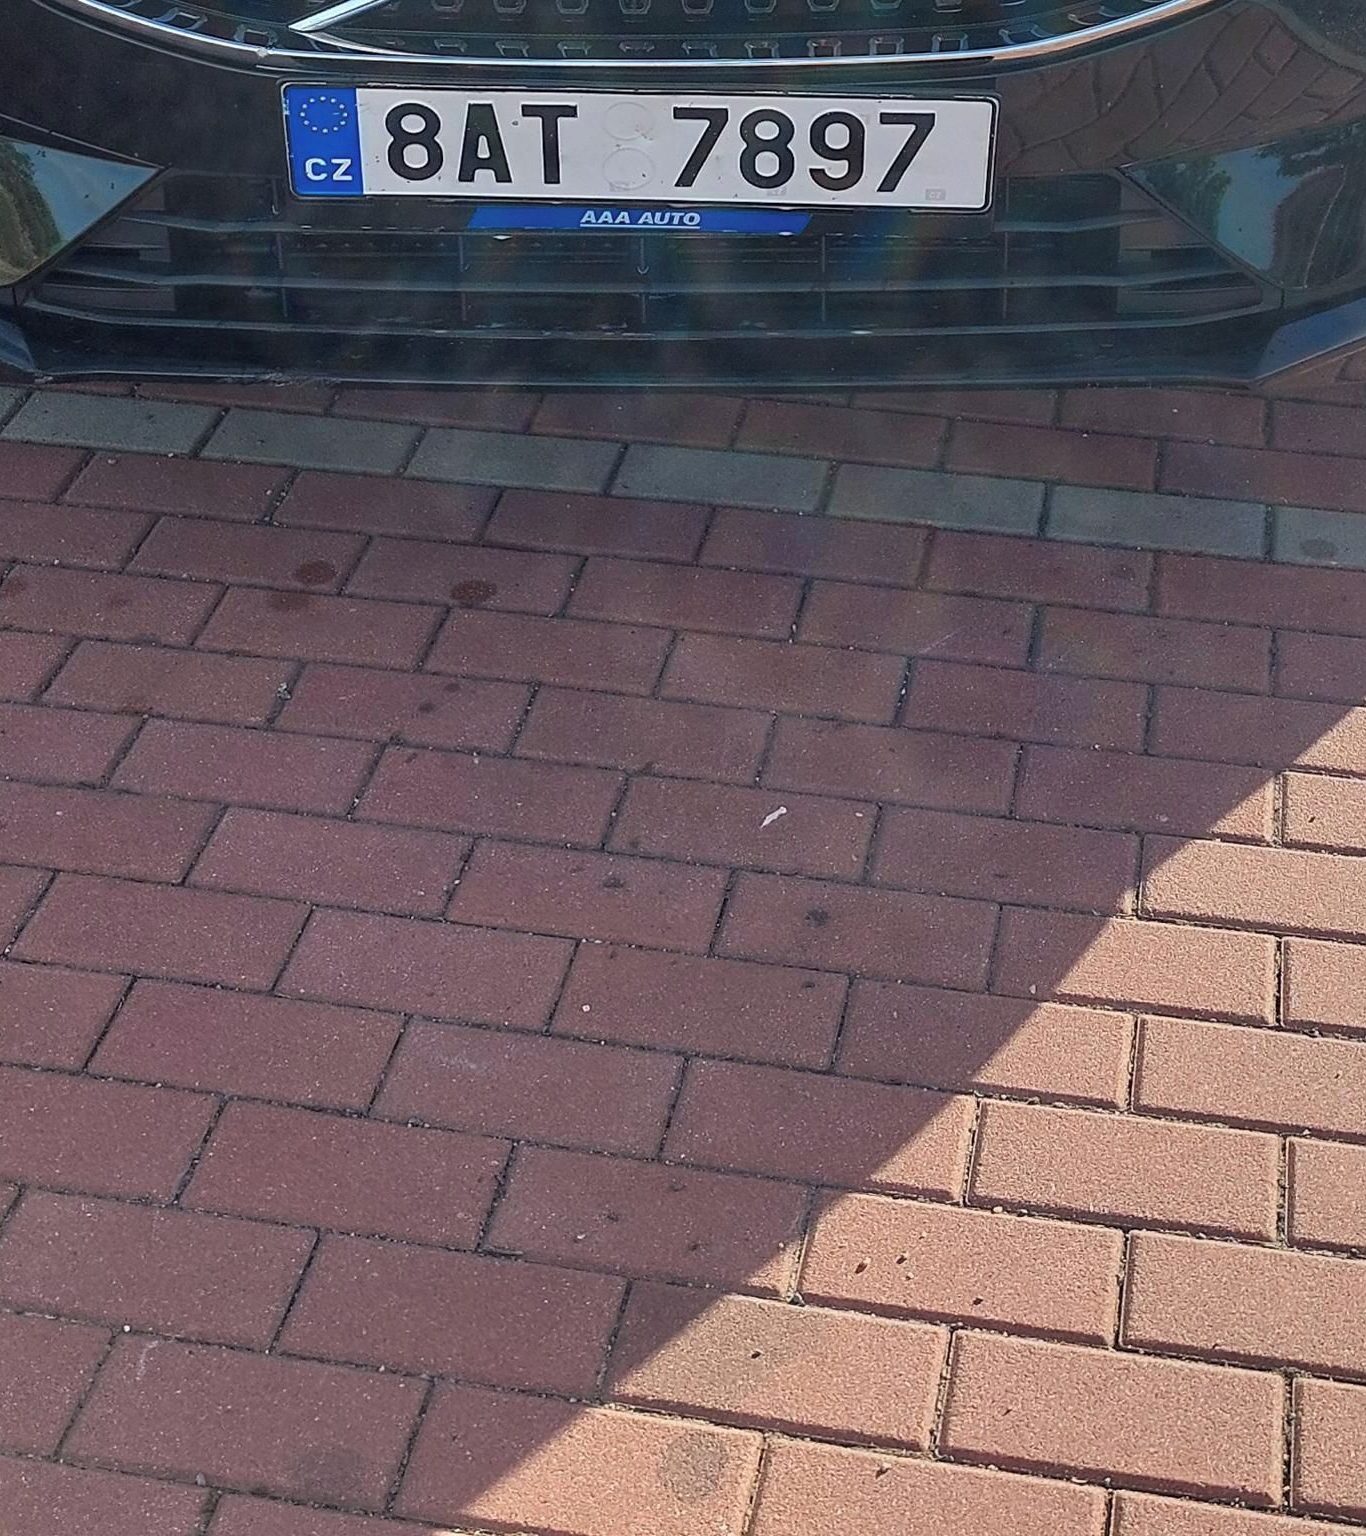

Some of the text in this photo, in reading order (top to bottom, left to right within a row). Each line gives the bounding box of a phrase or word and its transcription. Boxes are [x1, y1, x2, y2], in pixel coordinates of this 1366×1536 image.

[384, 102, 936, 192] 8AT 7897
[305, 157, 353, 181] CZ
[580, 210, 701, 226] AAA AUTO
